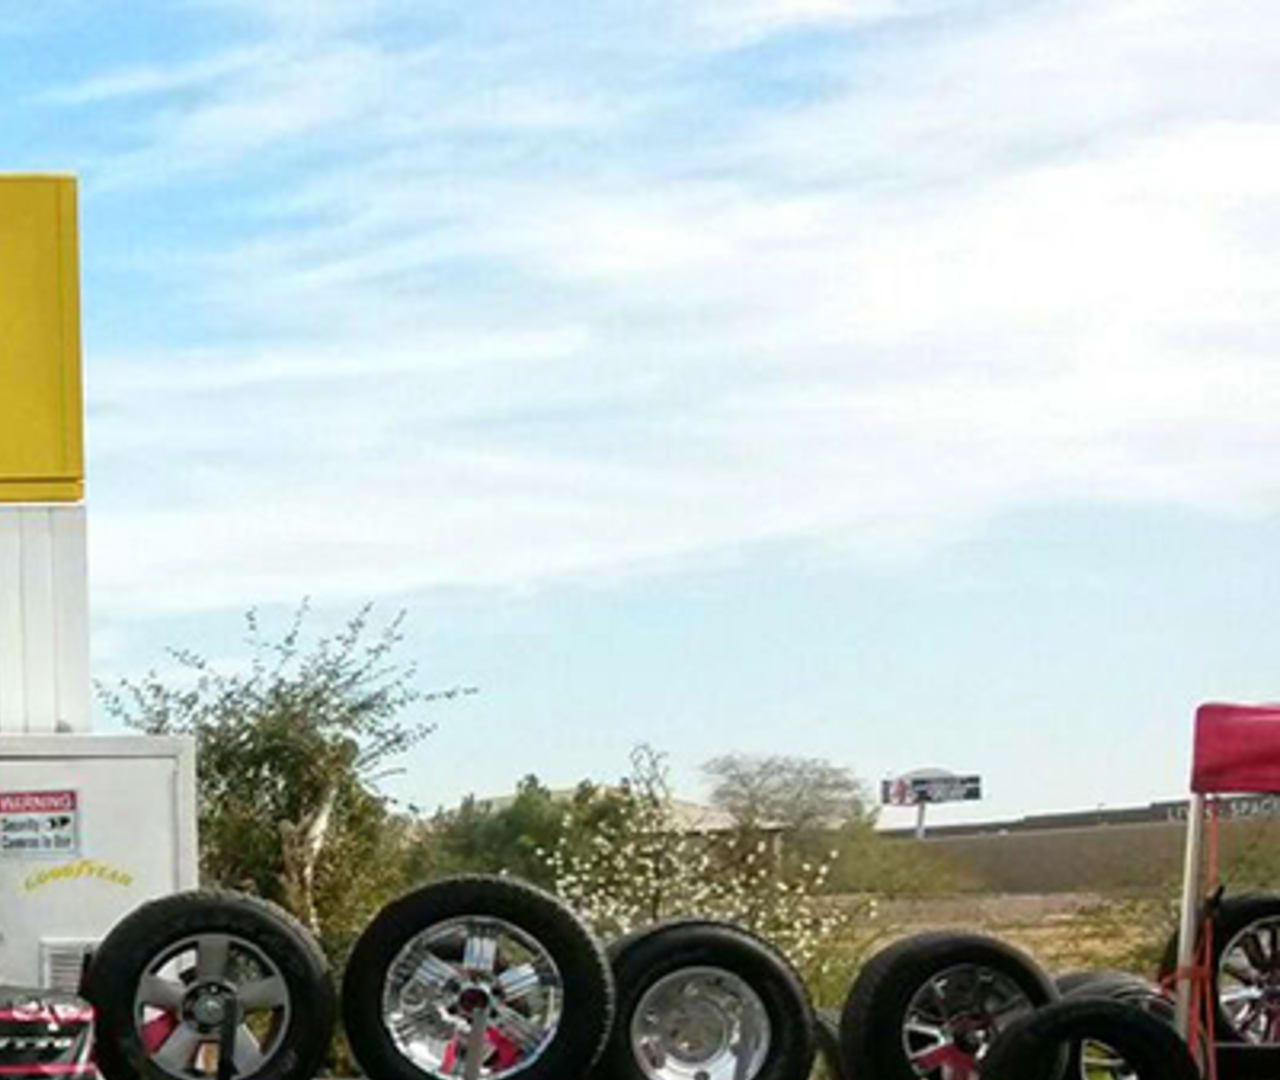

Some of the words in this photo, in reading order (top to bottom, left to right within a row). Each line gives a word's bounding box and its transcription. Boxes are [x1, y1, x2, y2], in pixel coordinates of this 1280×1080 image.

[0, 796, 71, 811] WARNING
[1, 818, 40, 834] Security
[24, 858, 133, 893] GOODYEAR
